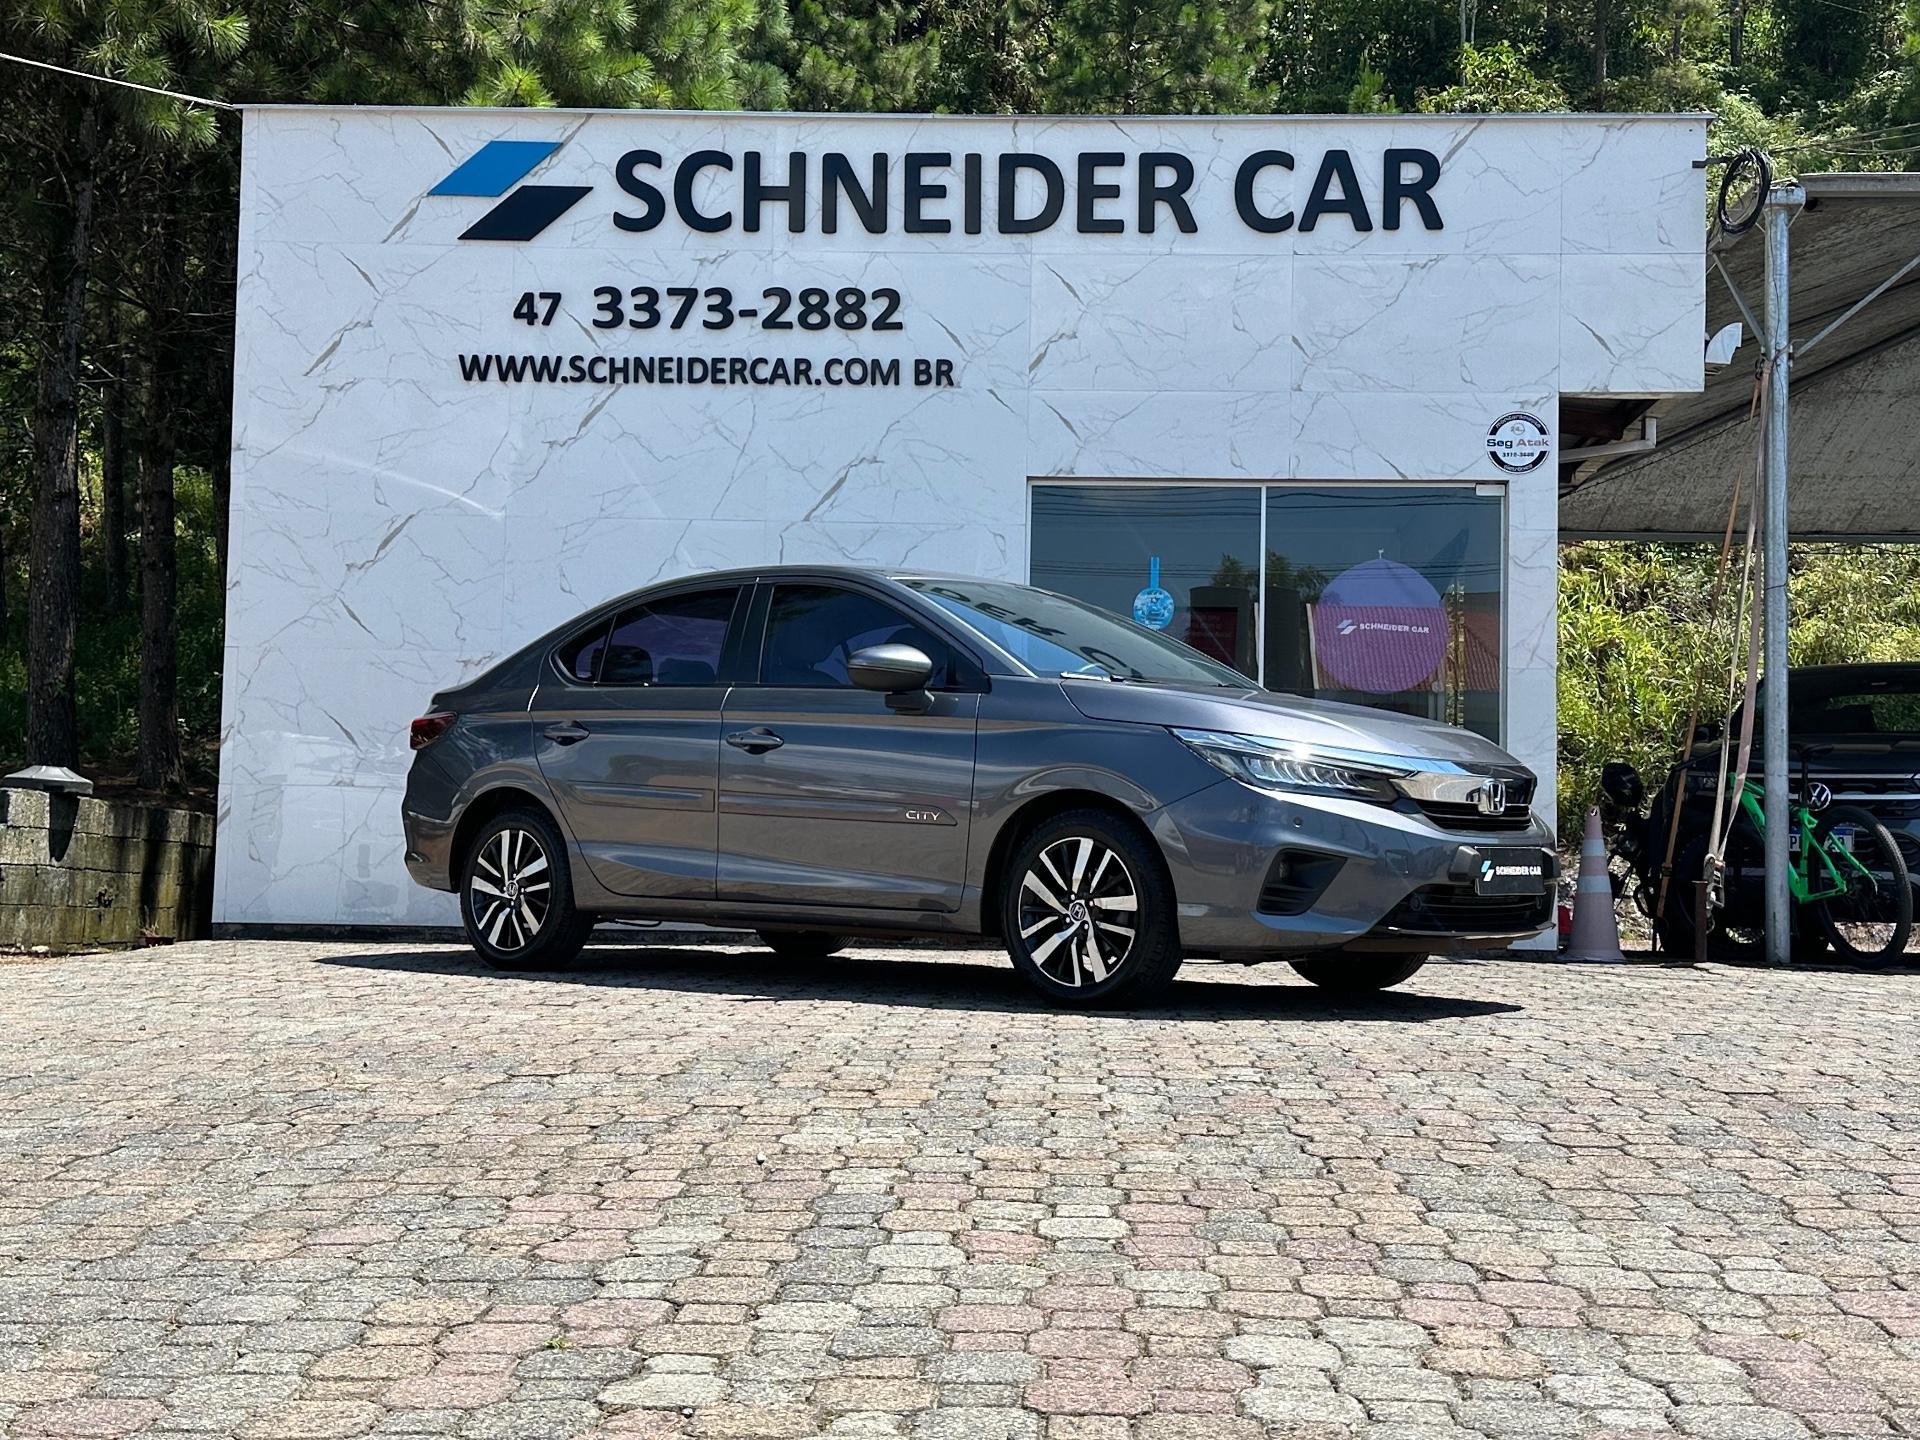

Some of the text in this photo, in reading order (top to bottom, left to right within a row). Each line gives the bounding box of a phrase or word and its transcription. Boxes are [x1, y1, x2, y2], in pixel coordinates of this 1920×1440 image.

[613, 148, 1444, 234] SCHNEIDER CAR
[513, 286, 903, 331] 47 3373-2882
[458, 354, 954, 386] WWW.SCHNEIDERCAR.COM BR
[1487, 438, 1549, 449] Seg Atak
[1359, 622, 1430, 634] SCHNEIDER CAR
[1495, 866, 1542, 875] SCHNEIDER CAR
